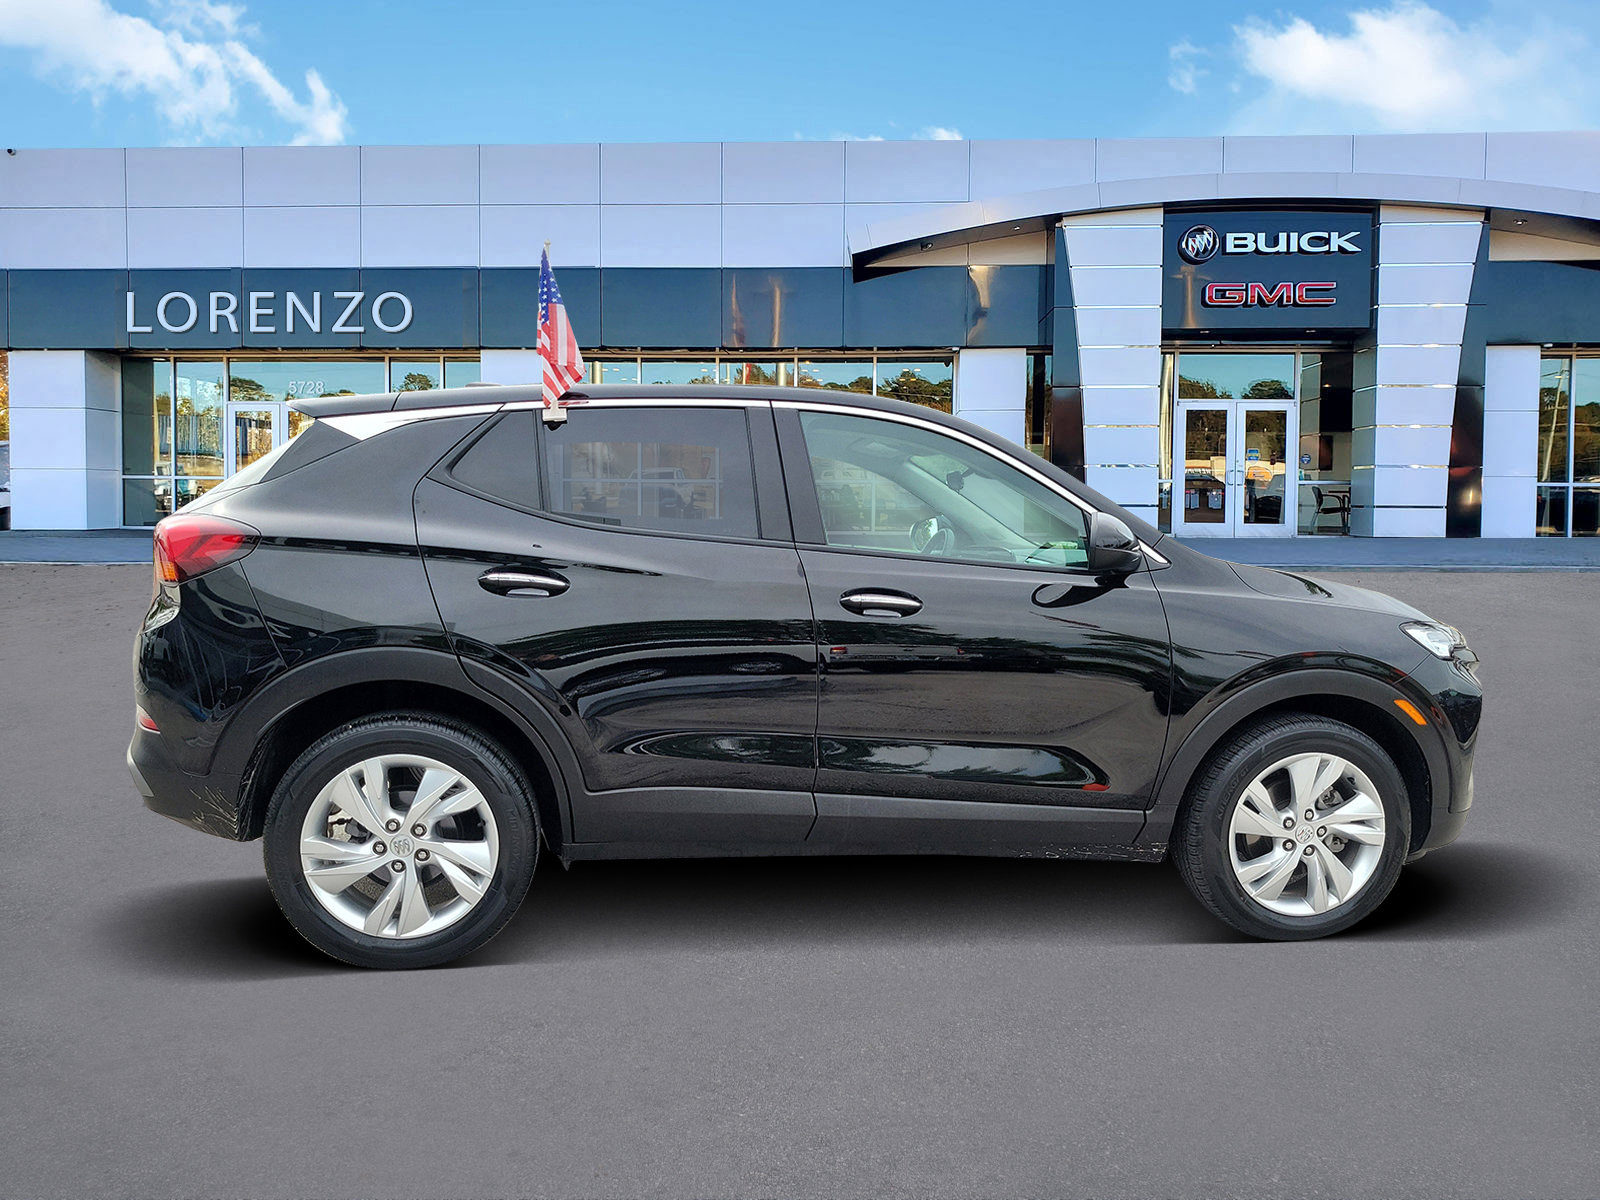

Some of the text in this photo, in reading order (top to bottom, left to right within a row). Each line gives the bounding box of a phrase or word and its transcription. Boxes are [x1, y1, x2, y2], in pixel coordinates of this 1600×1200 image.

[1225, 231, 1362, 253] BUICK
[1205, 281, 1337, 305] GMC
[126, 290, 414, 334] LORENZO
[288, 380, 325, 394] 5728
